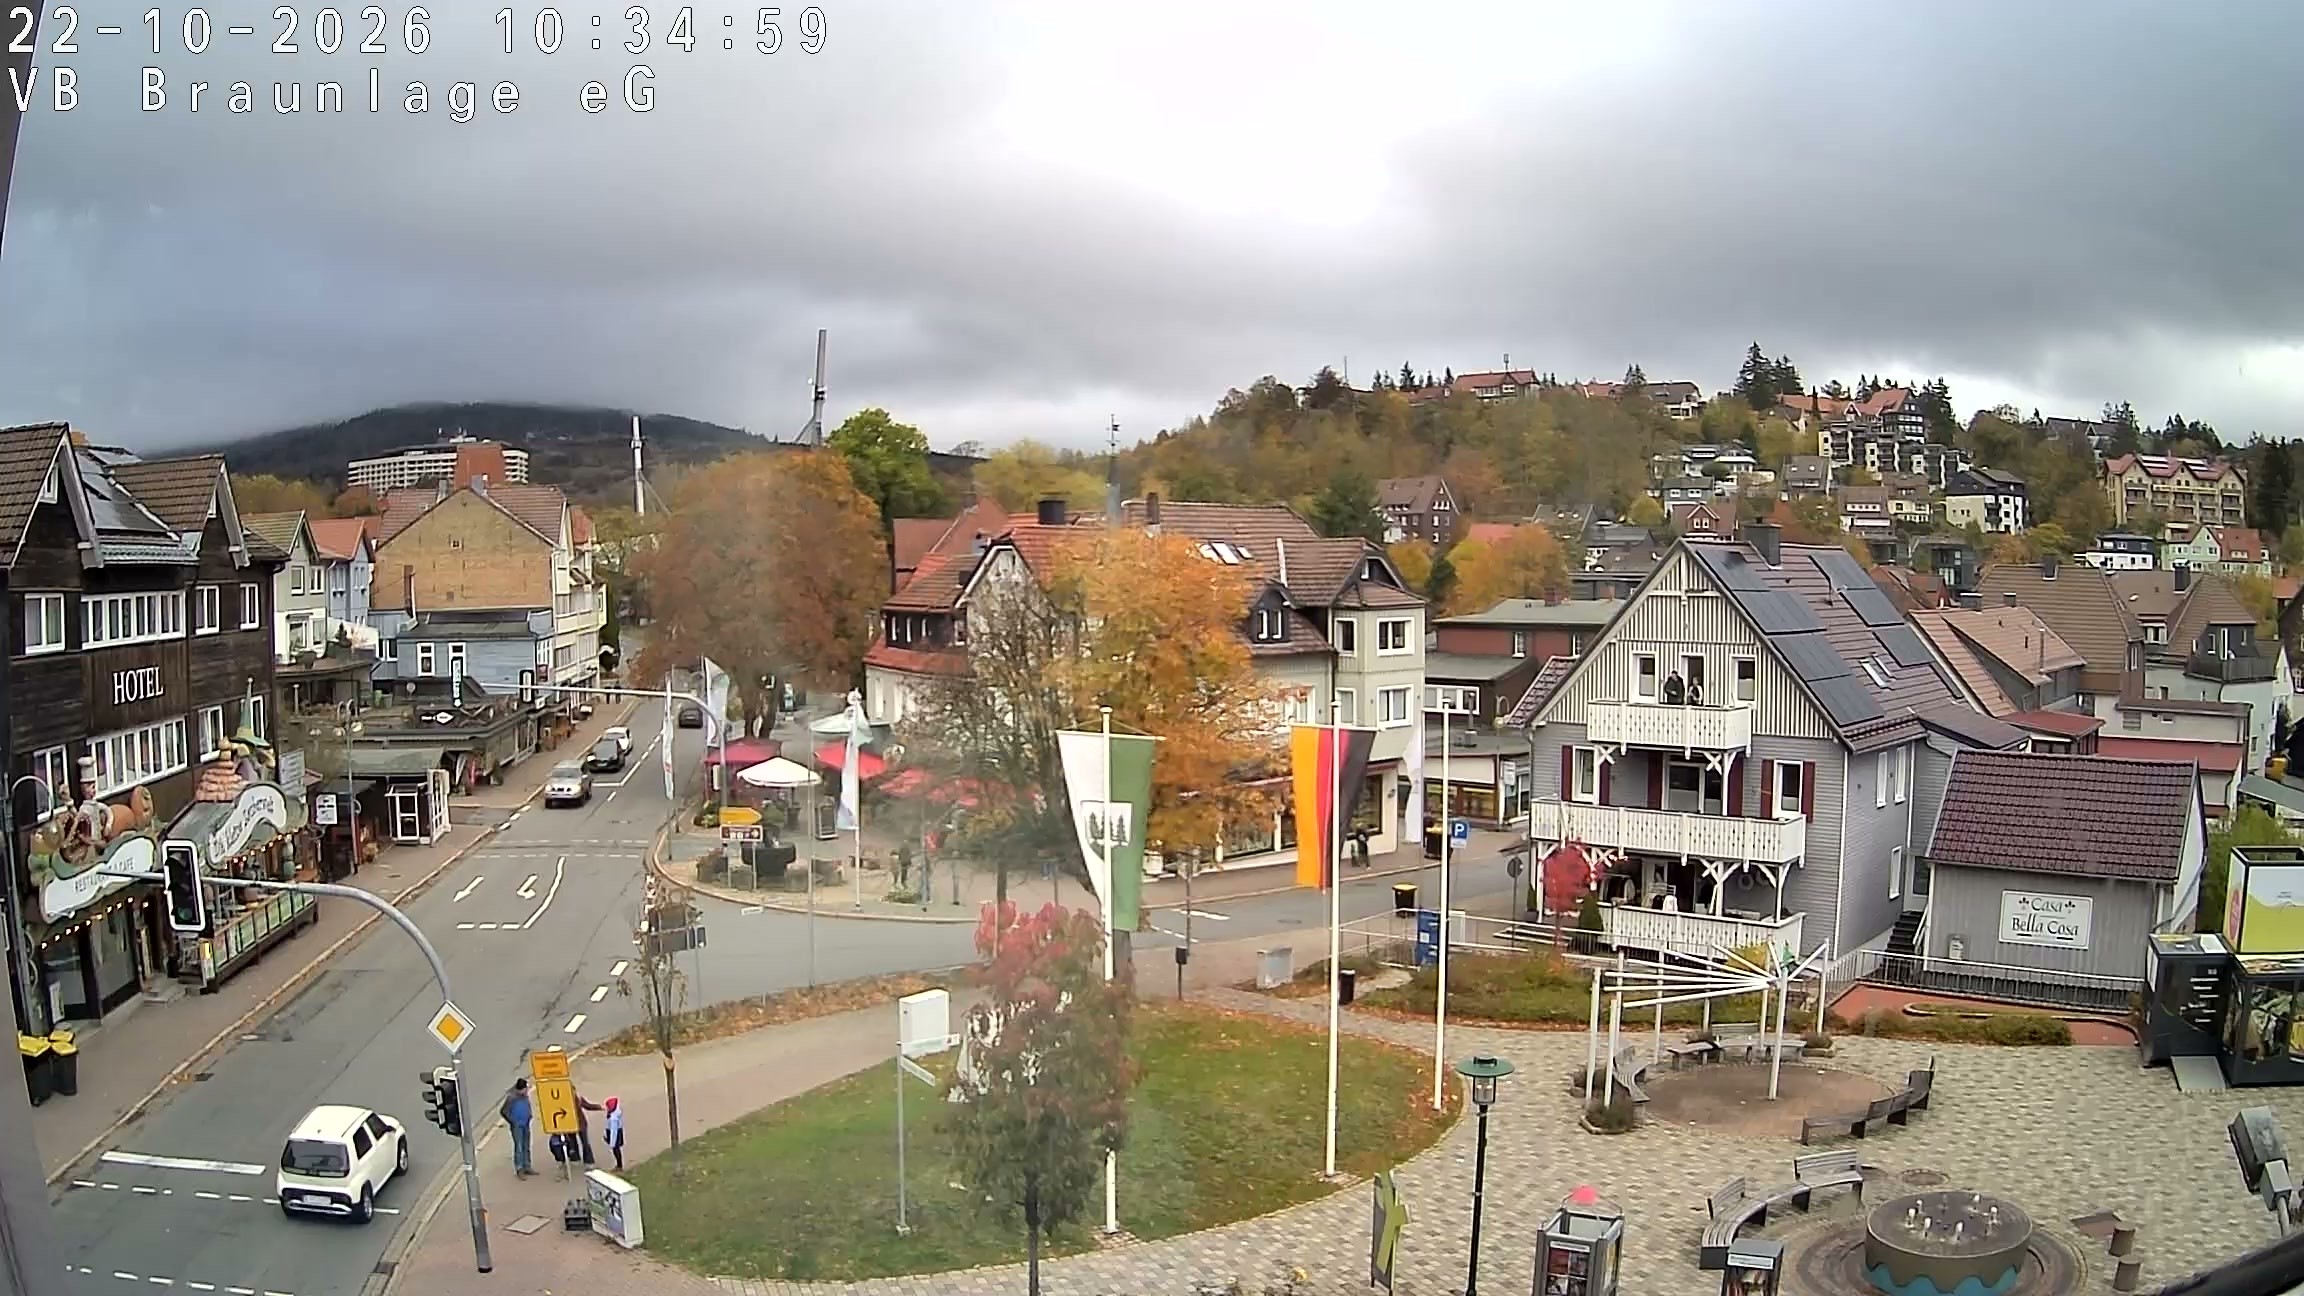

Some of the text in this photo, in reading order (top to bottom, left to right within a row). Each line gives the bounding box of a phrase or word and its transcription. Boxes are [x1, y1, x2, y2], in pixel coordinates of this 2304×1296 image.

[113, 667, 164, 705] HOTEL
[1454, 823, 1465, 837] P
[2031, 898, 2063, 912] Casa
[2012, 913, 2079, 936] Bella Cosa
[551, 1088, 560, 1100] U
